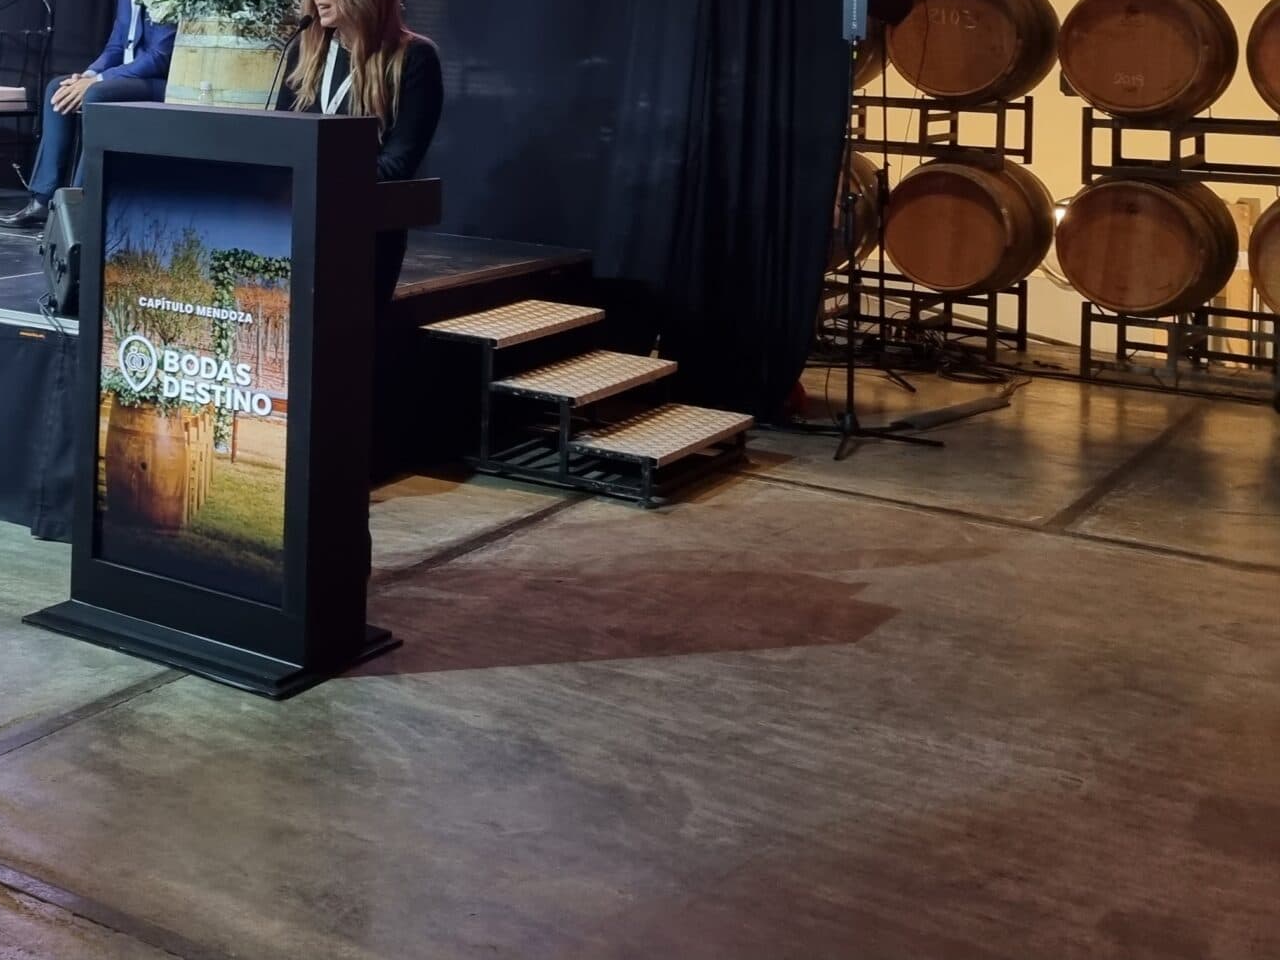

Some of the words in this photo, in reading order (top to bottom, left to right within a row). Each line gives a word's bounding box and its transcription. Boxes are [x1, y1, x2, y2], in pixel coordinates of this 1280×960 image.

[138, 297, 194, 314] CAPÍTULO
[196, 305, 253, 324] MENDOZA
[163, 350, 252, 386] BODAS
[163, 375, 272, 416] DESTINO
